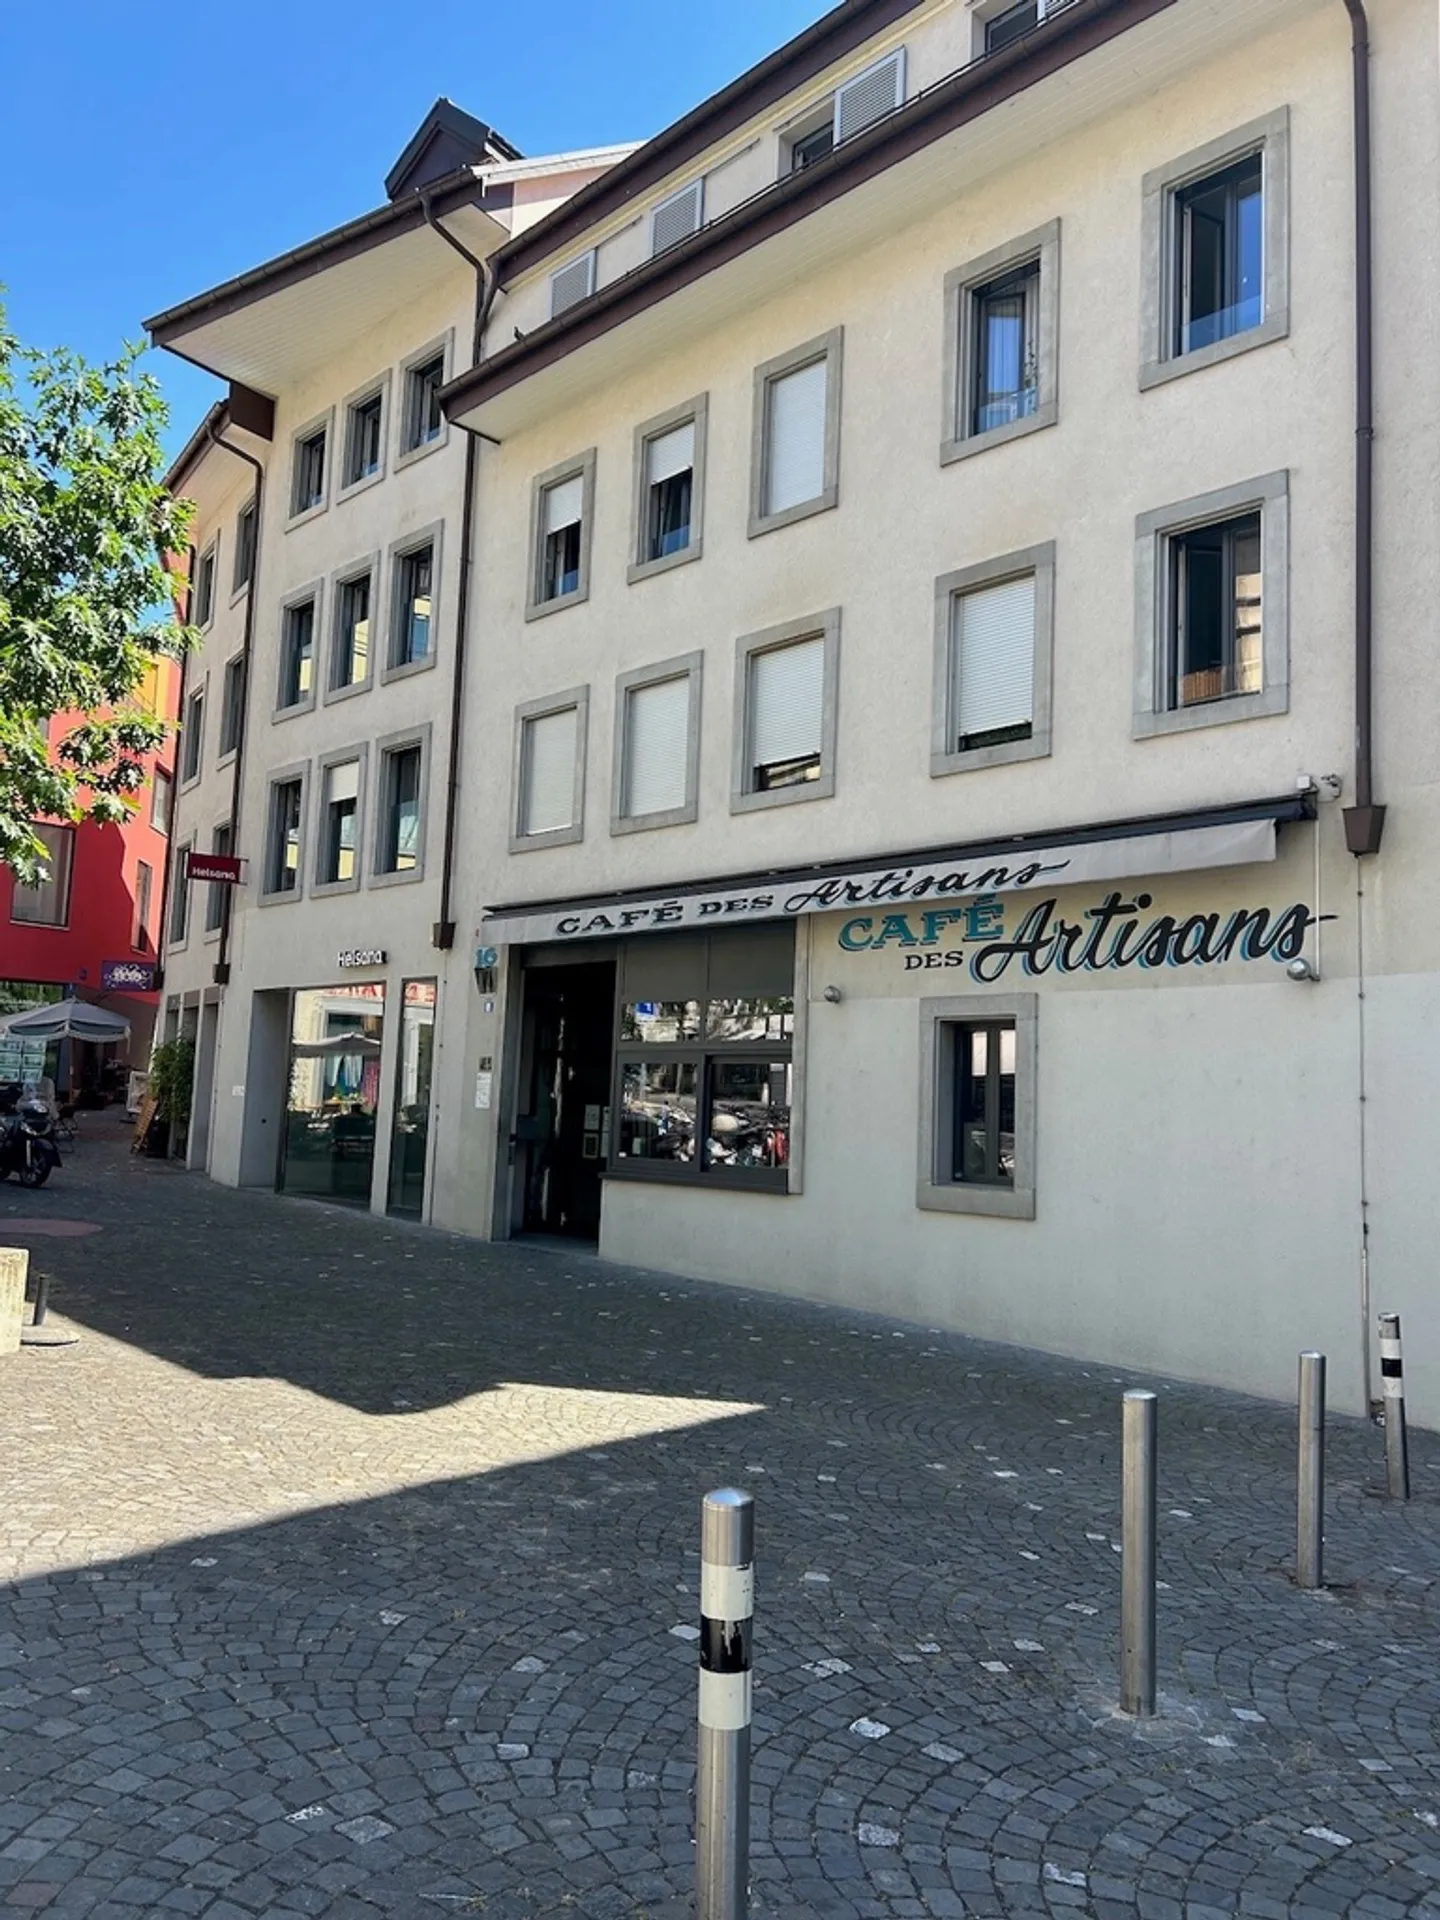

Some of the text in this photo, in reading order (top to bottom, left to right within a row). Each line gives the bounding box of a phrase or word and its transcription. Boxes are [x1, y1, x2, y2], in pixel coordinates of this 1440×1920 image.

[555, 859, 1070, 937] CAFÉ DES Artisans
[838, 893, 1005, 952] CAFÉ
[475, 946, 498, 969] 16
[904, 951, 964, 972] DES
[969, 892, 1338, 984] Artisans
